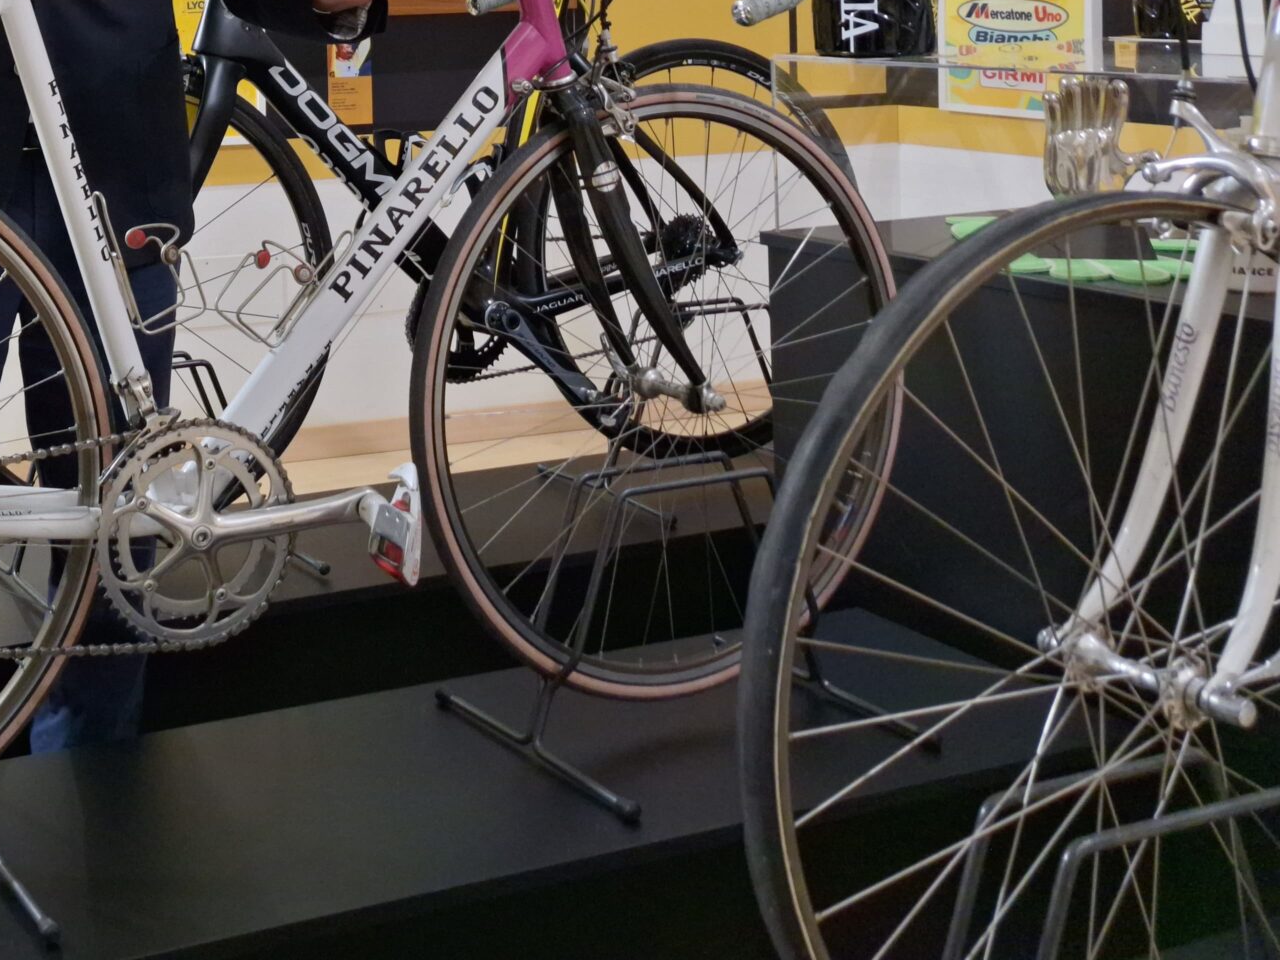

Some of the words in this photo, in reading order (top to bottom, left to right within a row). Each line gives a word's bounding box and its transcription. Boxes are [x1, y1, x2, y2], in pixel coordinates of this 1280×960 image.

[965, 2, 1033, 23] Mercatone
[1034, 5, 1062, 23] Uno
[268, 57, 399, 197] DOGM
[47, 78, 113, 263] PINARELLO
[329, 85, 500, 304] PINARELLO
[532, 293, 585, 314] JAGUAR
[654, 256, 705, 279] NARELLO
